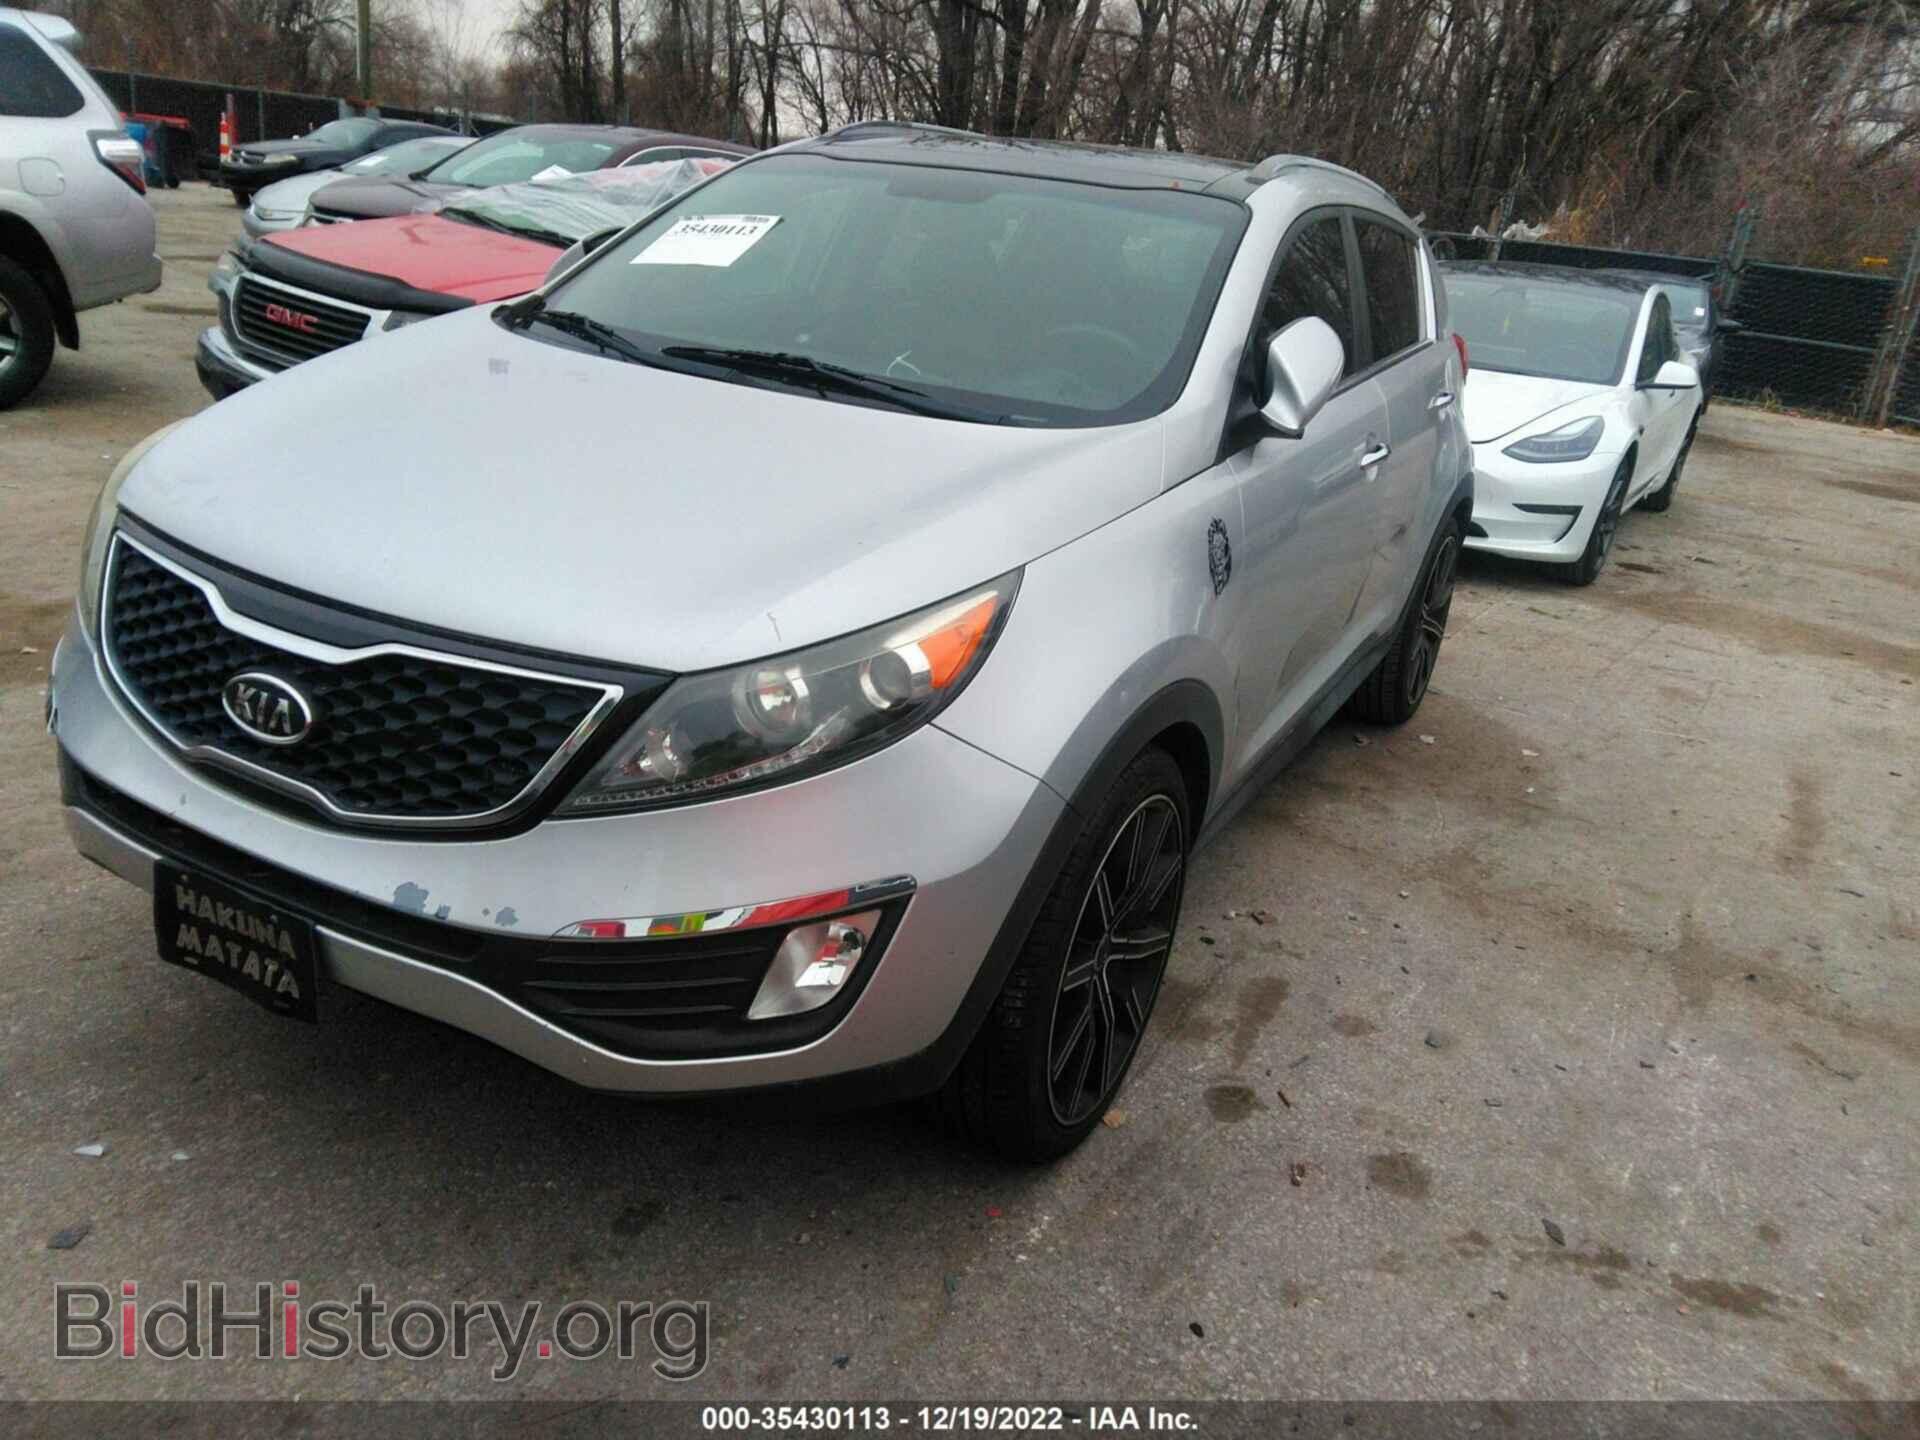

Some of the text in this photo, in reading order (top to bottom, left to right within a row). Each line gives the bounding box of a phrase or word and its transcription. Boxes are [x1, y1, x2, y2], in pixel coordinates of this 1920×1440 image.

[680, 223, 758, 236] 35430113
[264, 303, 320, 333] GMC
[234, 682, 292, 734] KIA
[175, 883, 297, 960] HAKUNA
[175, 922, 301, 1000] MATATA
